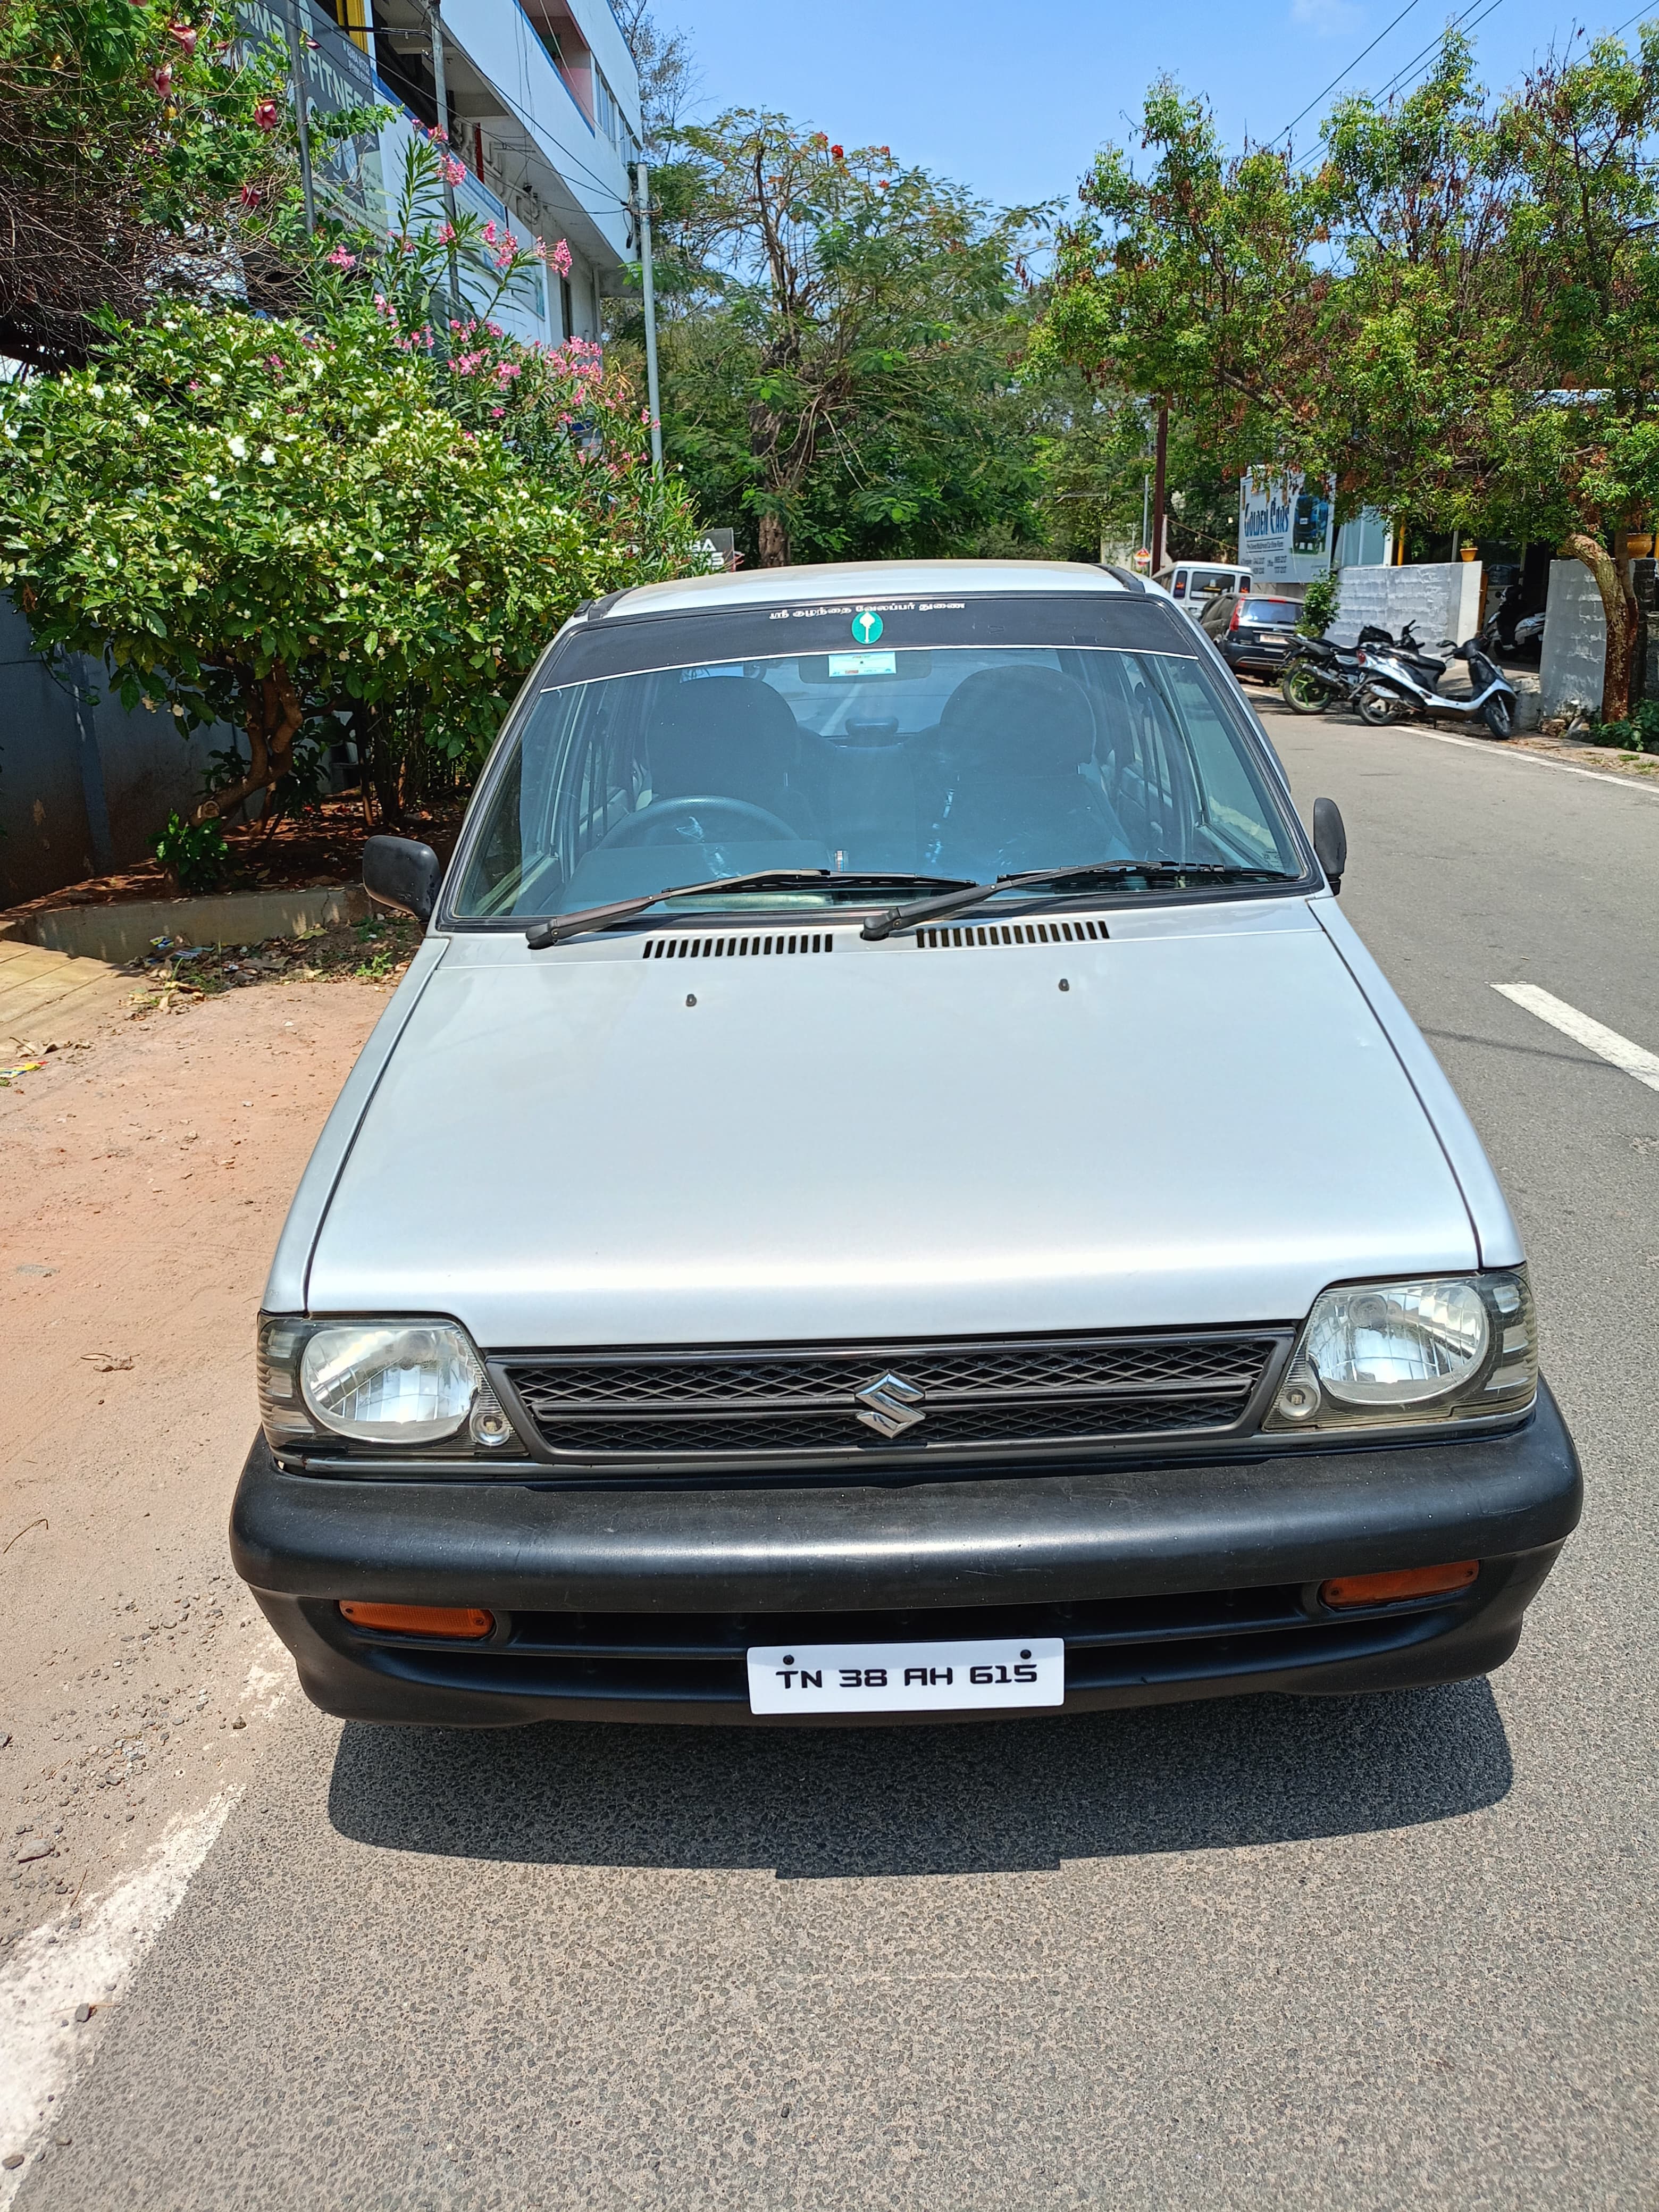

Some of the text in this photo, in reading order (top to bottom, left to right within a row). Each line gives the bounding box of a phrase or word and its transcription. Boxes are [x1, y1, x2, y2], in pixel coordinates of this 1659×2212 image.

[307, 45, 372, 115] FITNE
[918, 602, 965, 611] துணை
[776, 1664, 1037, 1689] TN 38 AH 615
